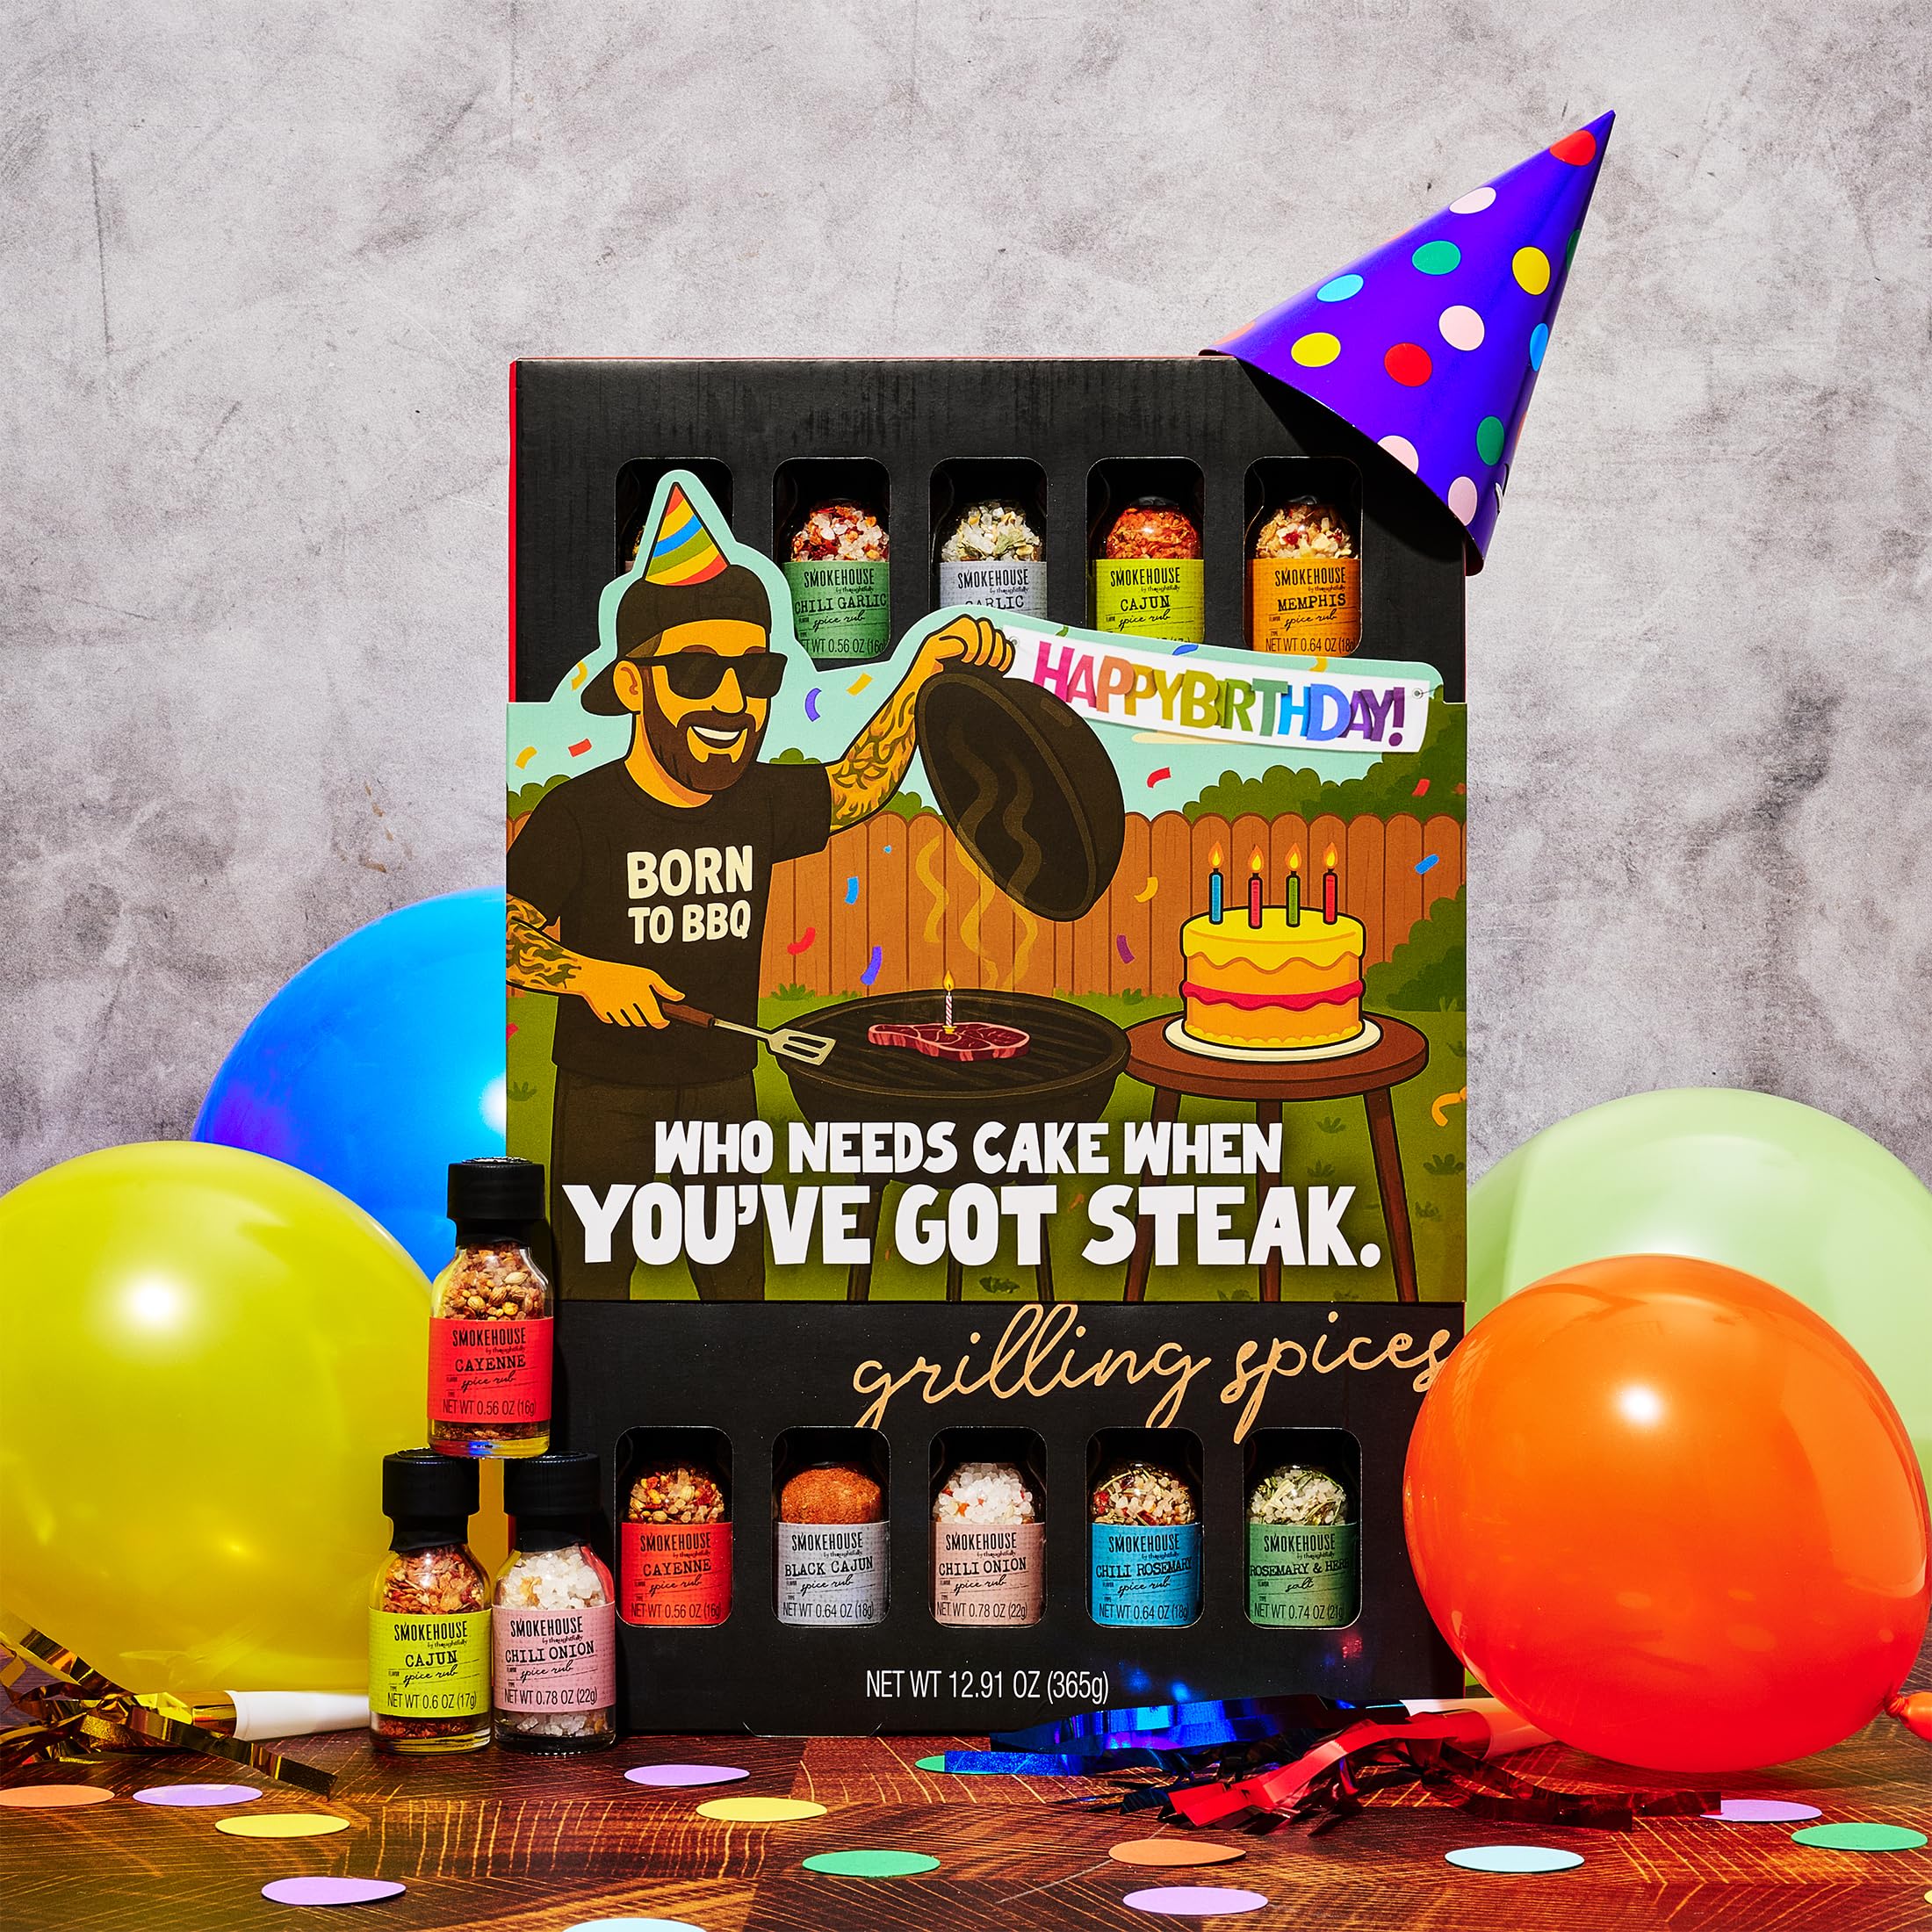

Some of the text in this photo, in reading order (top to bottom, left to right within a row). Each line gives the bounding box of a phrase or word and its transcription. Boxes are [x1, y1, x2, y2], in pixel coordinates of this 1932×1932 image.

[804, 568, 875, 588] SMOKEHOUSE
[958, 569, 1028, 588] SMOKEHOUSE
[1111, 567, 1180, 587] SMOKEHOUSE
[1275, 567, 1346, 587] SMOKEHOUSE
[795, 594, 886, 614] CHILI GARLIC
[1121, 595, 1170, 611] CAJUN
[1278, 594, 1346, 611] MEMPHIS
[813, 610, 865, 632] spice rub
[1119, 609, 1171, 631] spice rub
[1285, 609, 1337, 631] spice rub
[812, 639, 825, 652] WT
[828, 638, 849, 652] 0.56
[853, 639, 864, 652] OZ
[1266, 638, 1281, 652] NET
[1283, 638, 1298, 652] WT
[1301, 638, 1321, 652] 0.64
[1325, 638, 1337, 652] OZ
[627, 845, 753, 899] BORN
[628, 899, 751, 944] TO BBQ
[655, 1121, 1283, 1176] WHO NEEDS CAKE WHEN
[895, 1182, 1058, 1266] GOT
[1080, 1184, 1381, 1268] STEAK.
[452, 1328, 526, 1347] SMOKEHOUSE
[455, 1354, 526, 1372] CAYENNE
[461, 1370, 516, 1393] spice rub
[853, 1303, 1451, 1445] grilling spices
[443, 1400, 458, 1413] NET
[459, 1400, 474, 1414] WT
[477, 1400, 499, 1415] 0.56
[502, 1400, 515, 1415] OZ
[640, 1532, 711, 1552] SMOKEHOUSE
[792, 1532, 863, 1552] SMOKEHOUSE
[946, 1532, 1017, 1550] SMOKEHOUSE
[1109, 1533, 1179, 1553] SMOKEHOUSE
[1264, 1533, 1335, 1552] SMOKEHOUSE
[644, 1559, 711, 1576] CAYENNE
[785, 1556, 873, 1577] BLACK CAJUN
[940, 1557, 1027, 1575] CHILI ONION
[1096, 1556, 1192, 1578] CHILI ROSEMARY
[1250, 1563, 1309, 1576] ROSEMARY
[1313, 1562, 1323, 1574] &
[649, 1574, 702, 1597] spice rub
[800, 1574, 854, 1597] spice rub
[954, 1575, 1006, 1596] spice rub
[1118, 1575, 1171, 1598] spice rub
[1285, 1577, 1314, 1592] salt
[631, 1603, 645, 1617] NET
[648, 1604, 661, 1618] WT
[665, 1604, 686, 1618] 0.56
[689, 1604, 702, 1618] OZ
[783, 1601, 874, 1619] NET WT 0.64 OZ (18g)
[937, 1602, 1027, 1620] NET WT 0.78 OZ (22g)
[1099, 1604, 1114, 1618] NET
[1116, 1604, 1131, 1618] WT
[1134, 1605, 1154, 1619] 0.64
[1157, 1605, 1170, 1619] OZ
[1255, 1603, 1269, 1617] NET
[1272, 1604, 1286, 1618] WT
[1289, 1605, 1309, 1619] 0.74
[1313, 1605, 1325, 1619] OZ
[394, 1621, 467, 1641] SMOKEHOUSE
[510, 1616, 583, 1638] SMOKEHOUSE
[406, 1650, 458, 1667] CAJUN
[506, 1640, 595, 1663] CHILI ONION
[403, 1664, 458, 1688] spice rub
[520, 1660, 573, 1683] spice rub
[504, 1686, 597, 1705] NET WT 0.78 OZ (22g)
[866, 1669, 1109, 1705] NET WT 12.91 OZ (365g)
[388, 1691, 477, 1710] NET WT 0.6 OZ (17g)
